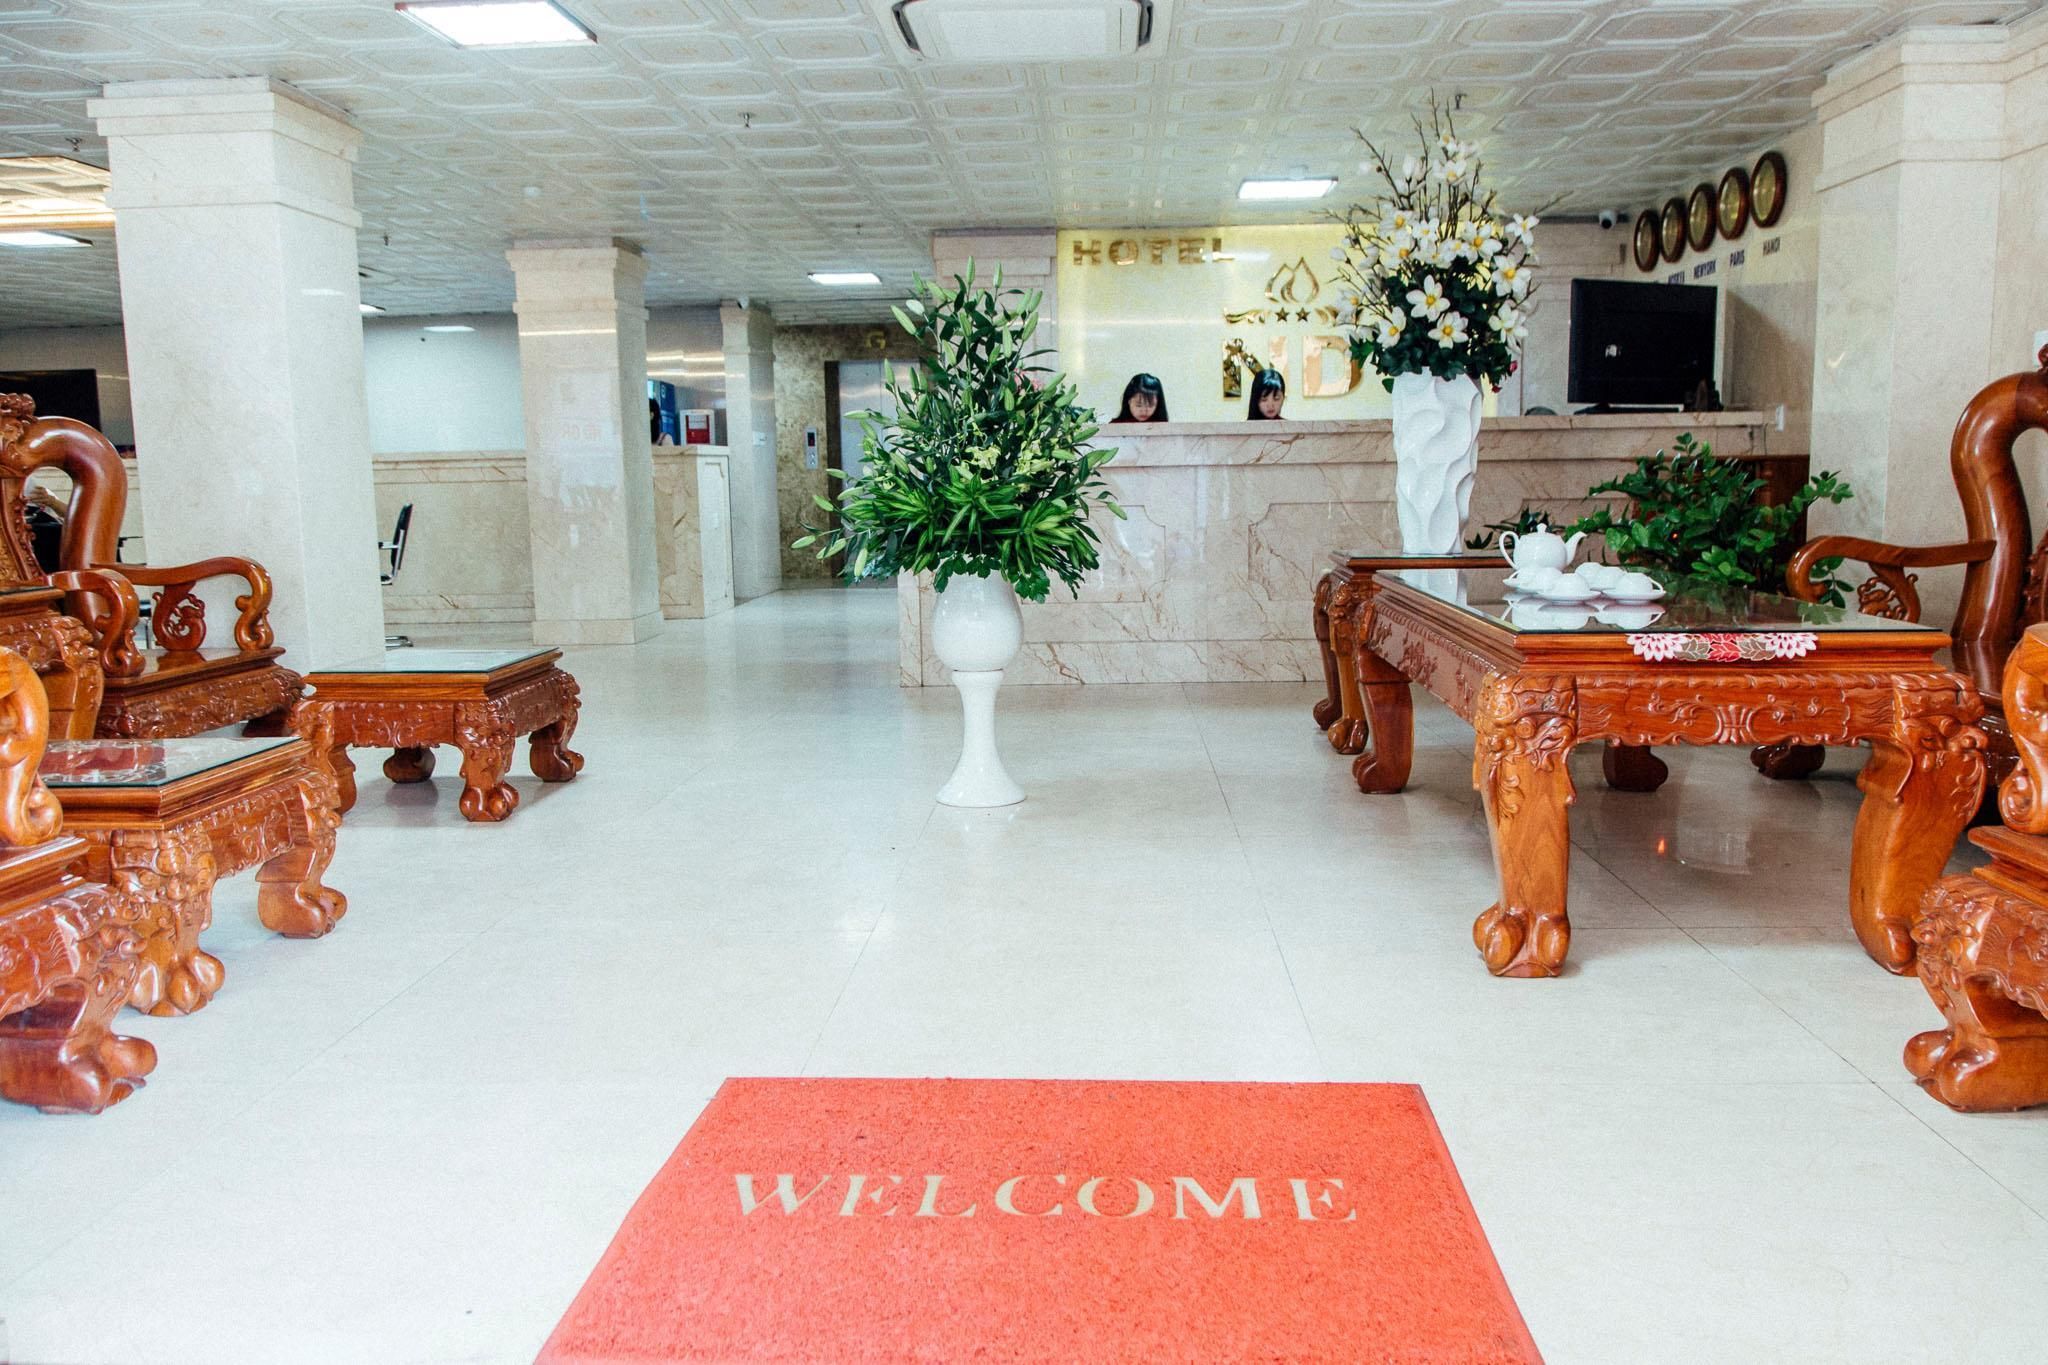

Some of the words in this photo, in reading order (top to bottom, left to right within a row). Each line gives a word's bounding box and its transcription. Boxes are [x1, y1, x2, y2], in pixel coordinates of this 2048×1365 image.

[1073, 237, 1235, 266] HOTEL
[1729, 249, 1745, 268] PARIS
[1762, 237, 1781, 256] HANOI
[1222, 335, 1362, 401] ND
[733, 1173, 1357, 1221] WELCOME
